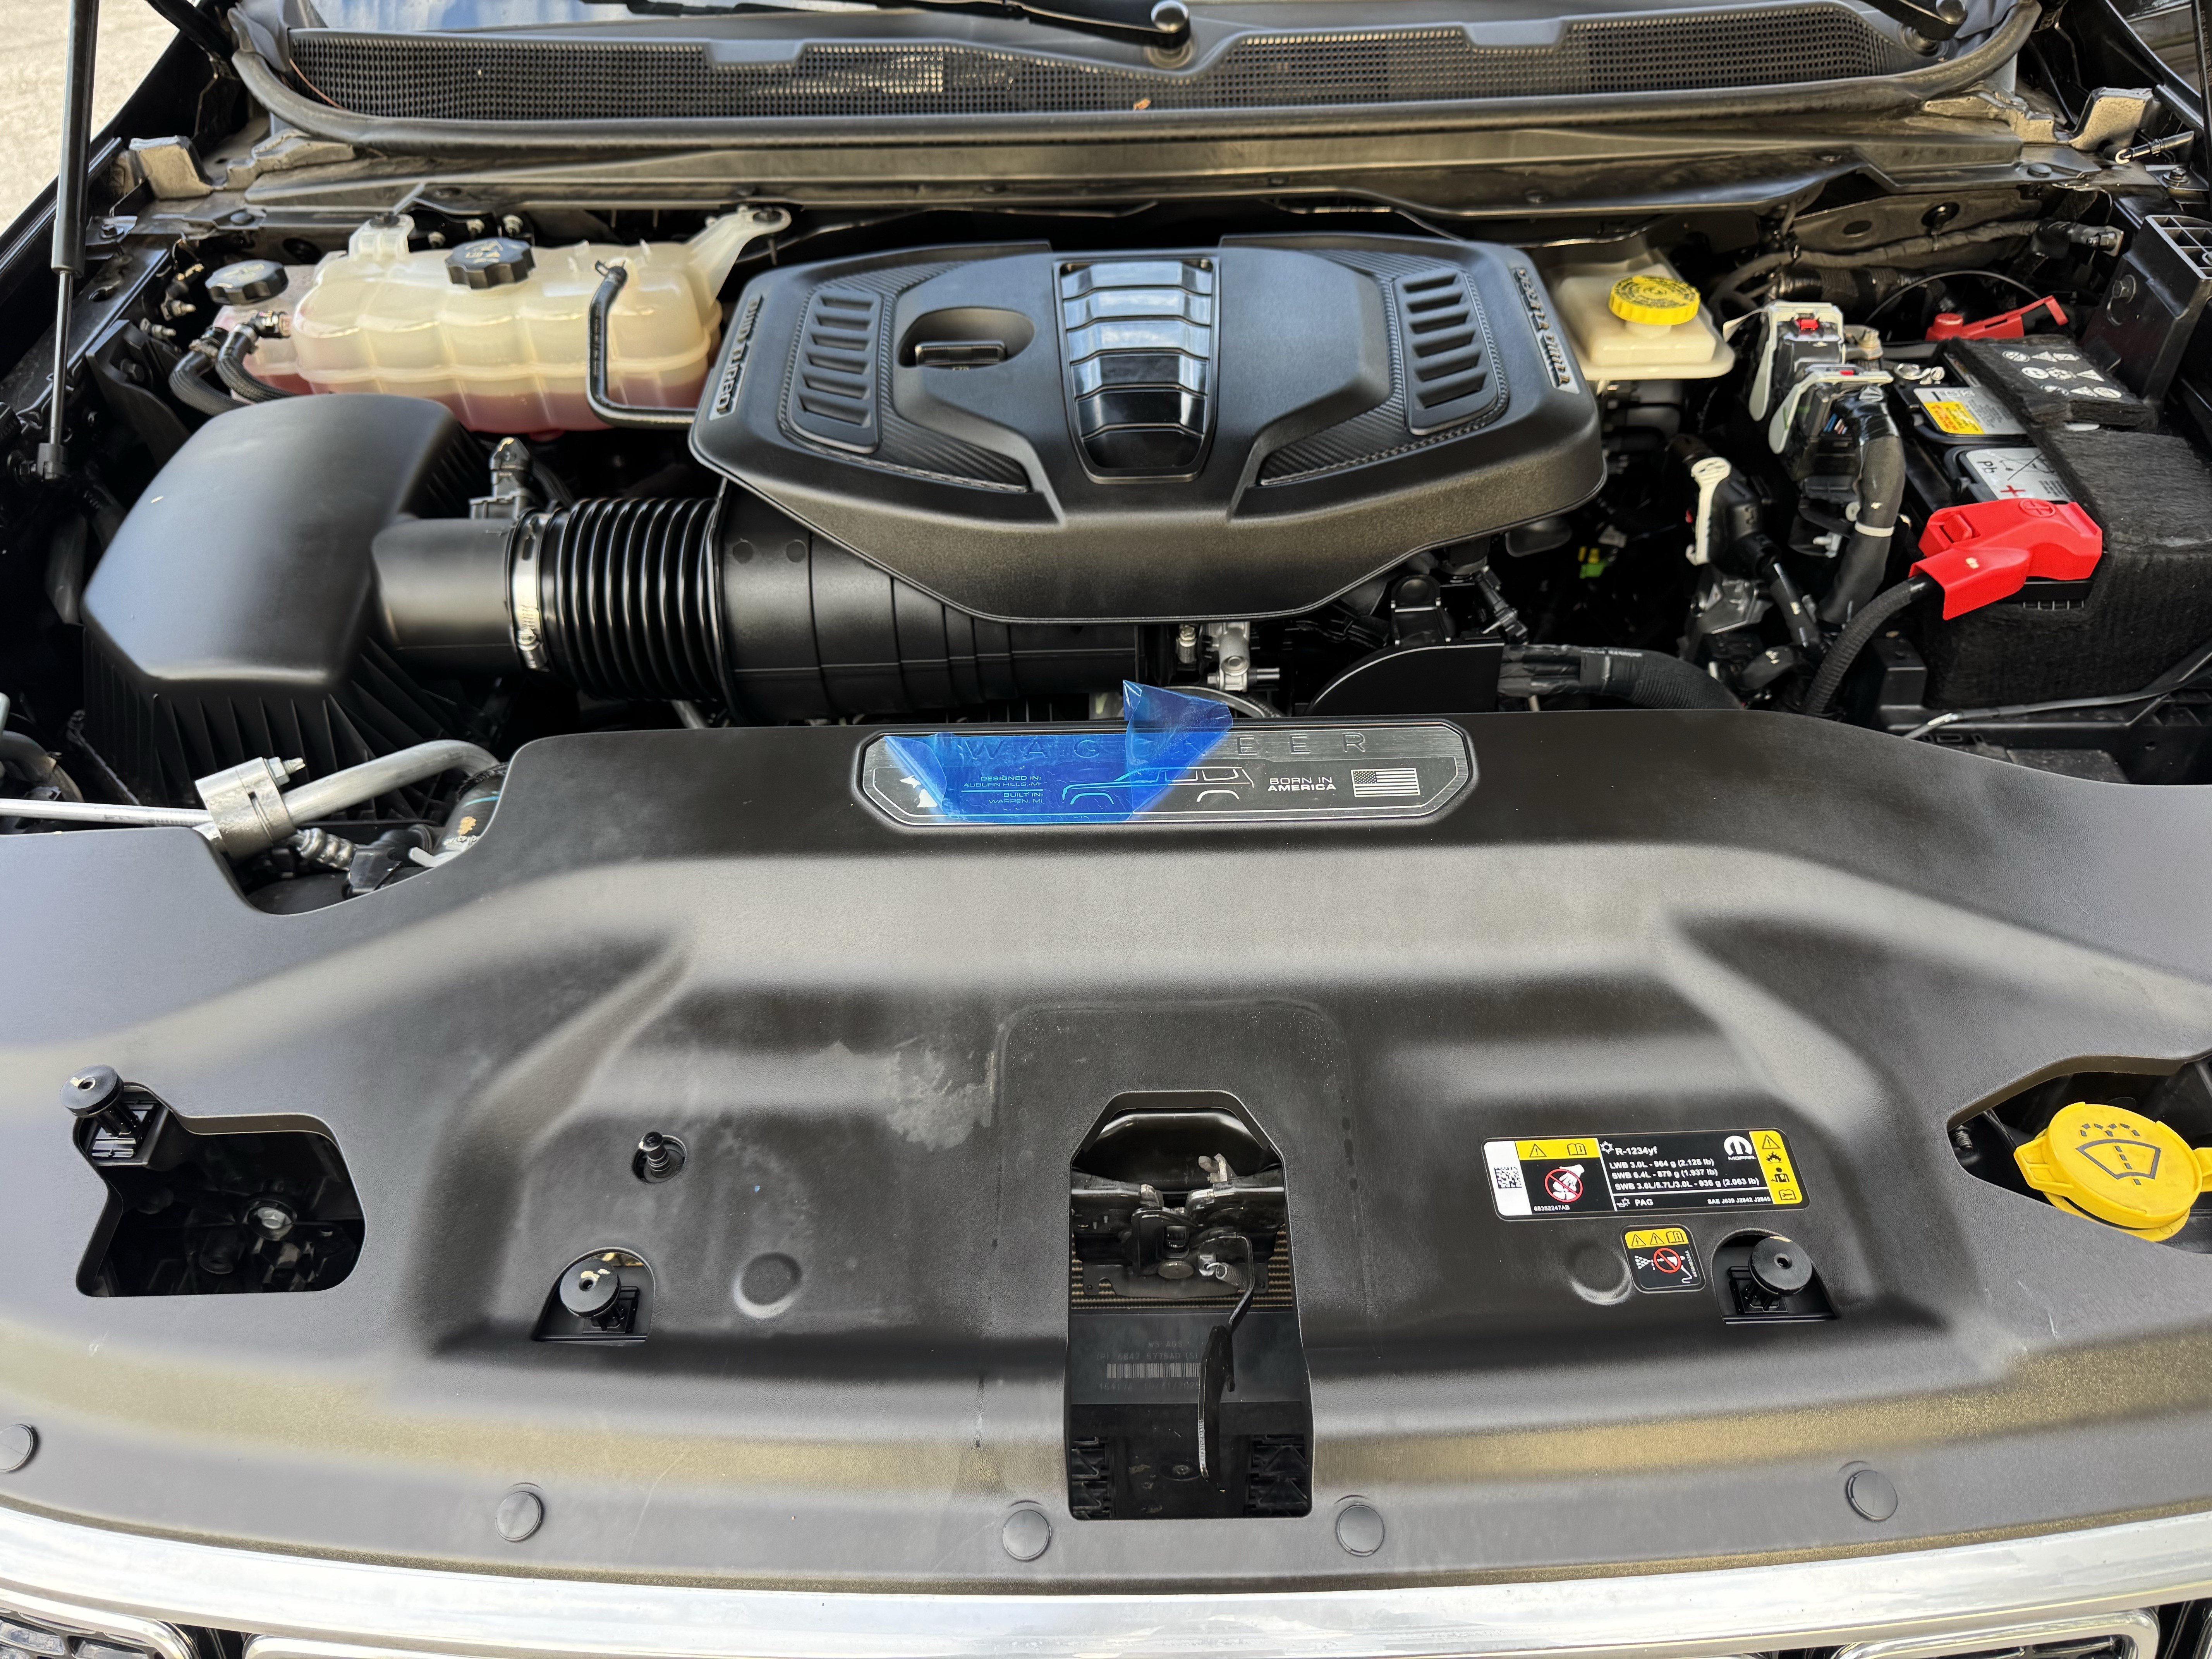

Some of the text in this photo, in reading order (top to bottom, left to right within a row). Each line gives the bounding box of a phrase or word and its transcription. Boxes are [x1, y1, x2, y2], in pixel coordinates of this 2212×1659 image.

[1267, 783, 1336, 792] AMERICA
[1615, 1146, 1657, 1156] R-1234yf
[1678, 1159, 1702, 1168] (2.125
[1703, 1158, 1714, 1166] lb)
[1706, 1168, 1718, 1176] lb)
[1748, 1177, 1760, 1186] lb)
